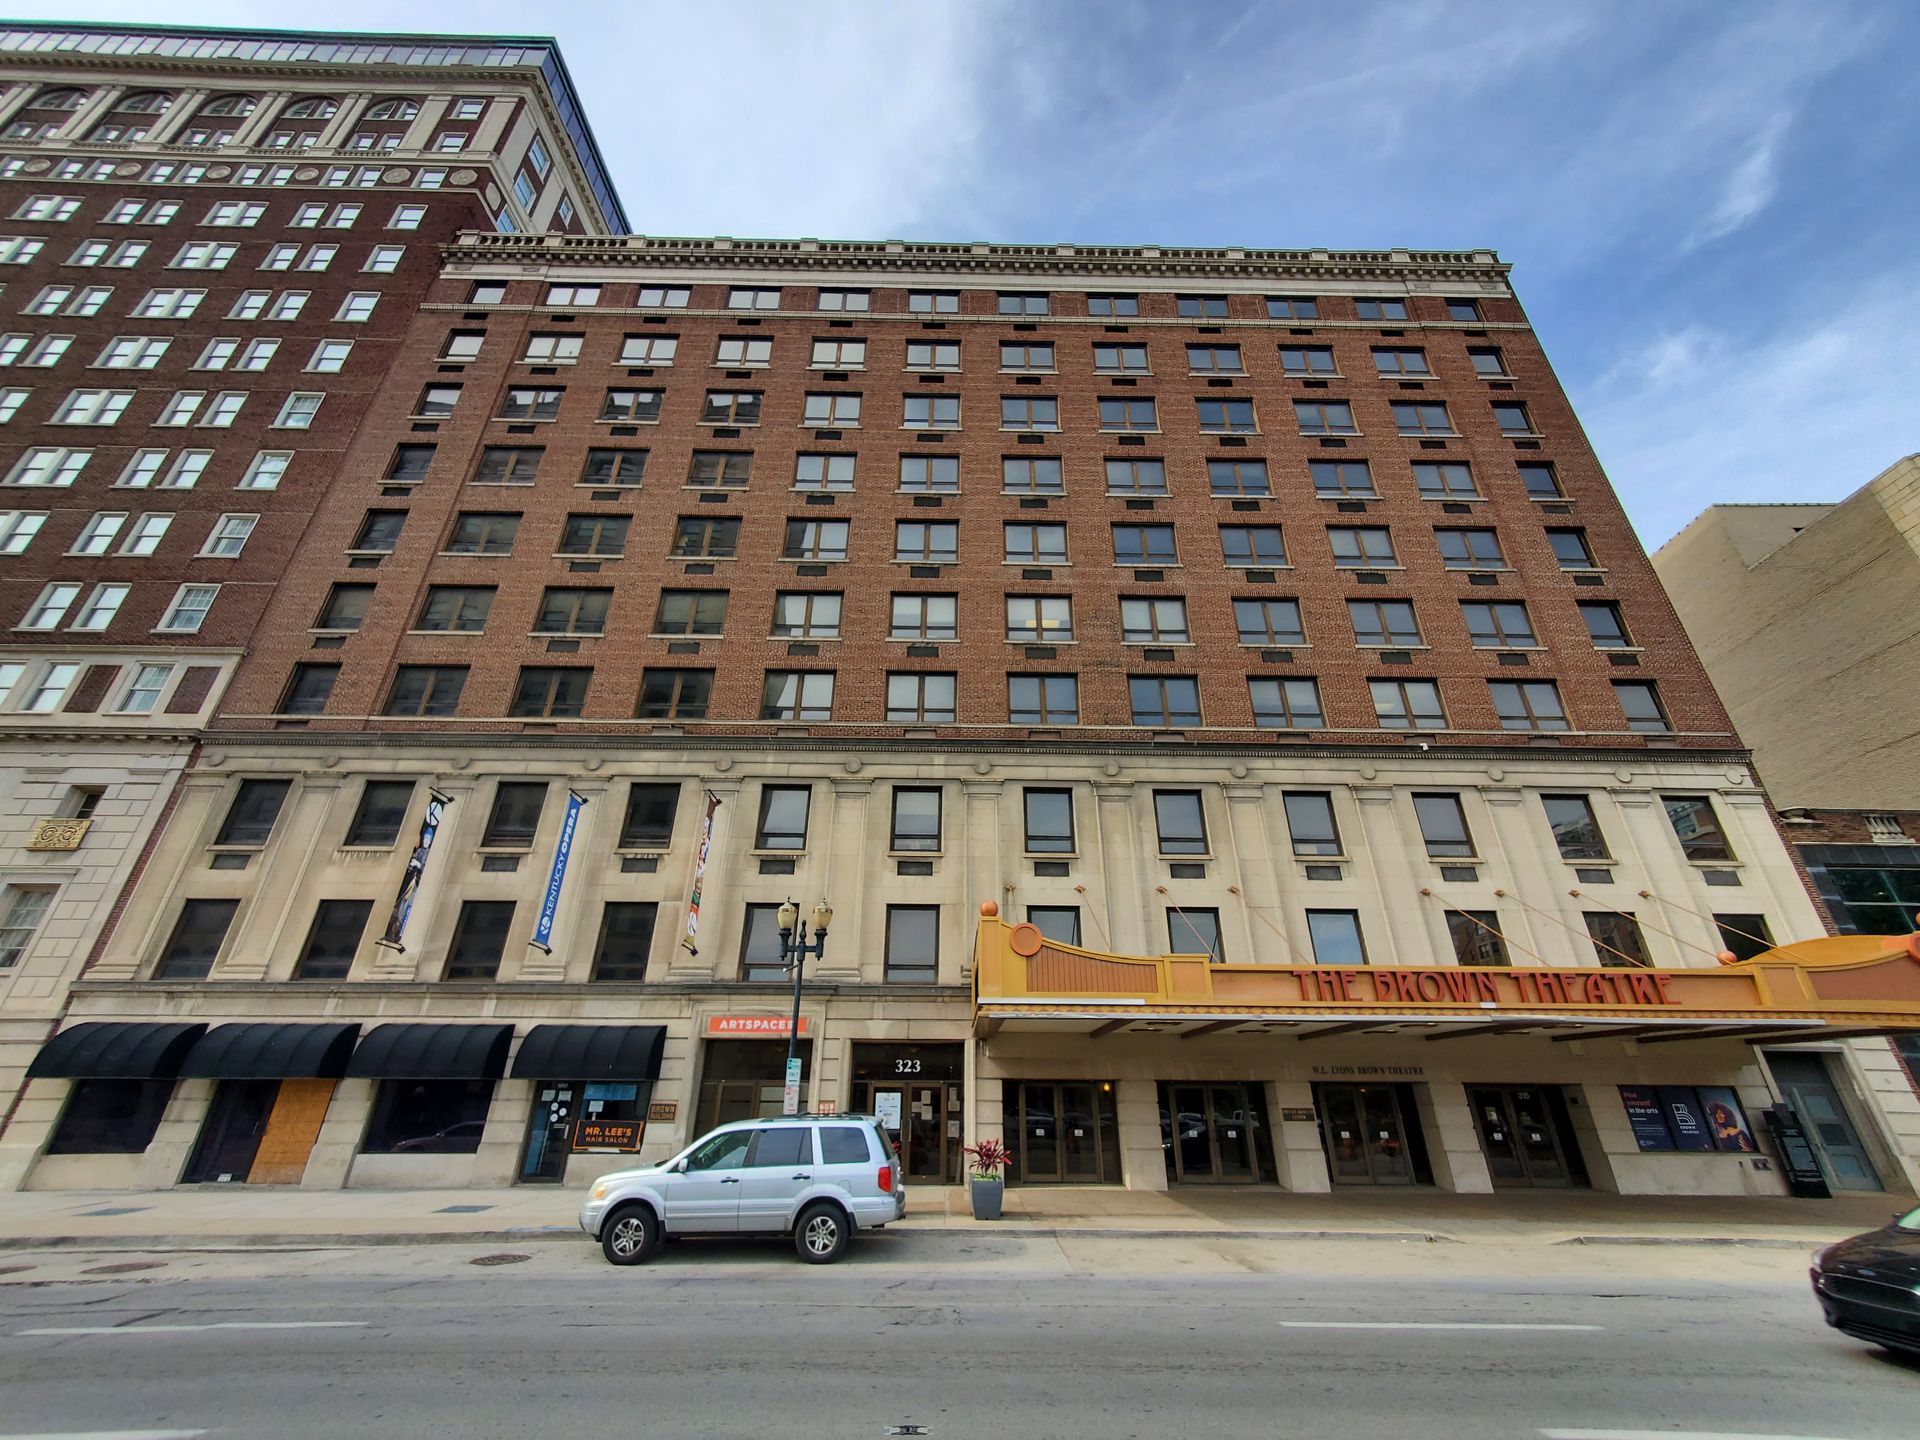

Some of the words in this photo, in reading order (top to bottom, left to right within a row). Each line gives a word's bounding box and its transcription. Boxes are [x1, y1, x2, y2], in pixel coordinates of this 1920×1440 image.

[546, 853, 566, 916] KENTUCKY
[561, 808, 577, 854] OPERA
[1292, 970, 1364, 1002] THE
[1372, 970, 1501, 1003] BROWN
[1509, 972, 1682, 1005] THEATRE
[895, 1059, 921, 1073] 323
[1331, 1065, 1355, 1075] LYONS
[1357, 1065, 1385, 1075] BROWN
[1387, 1066, 1425, 1075] THEATRE
[650, 1104, 676, 1113] BROWN
[585, 1126, 602, 1136] MR.
[605, 1126, 633, 1137] LEE'S
[604, 1136, 628, 1144] SALON
